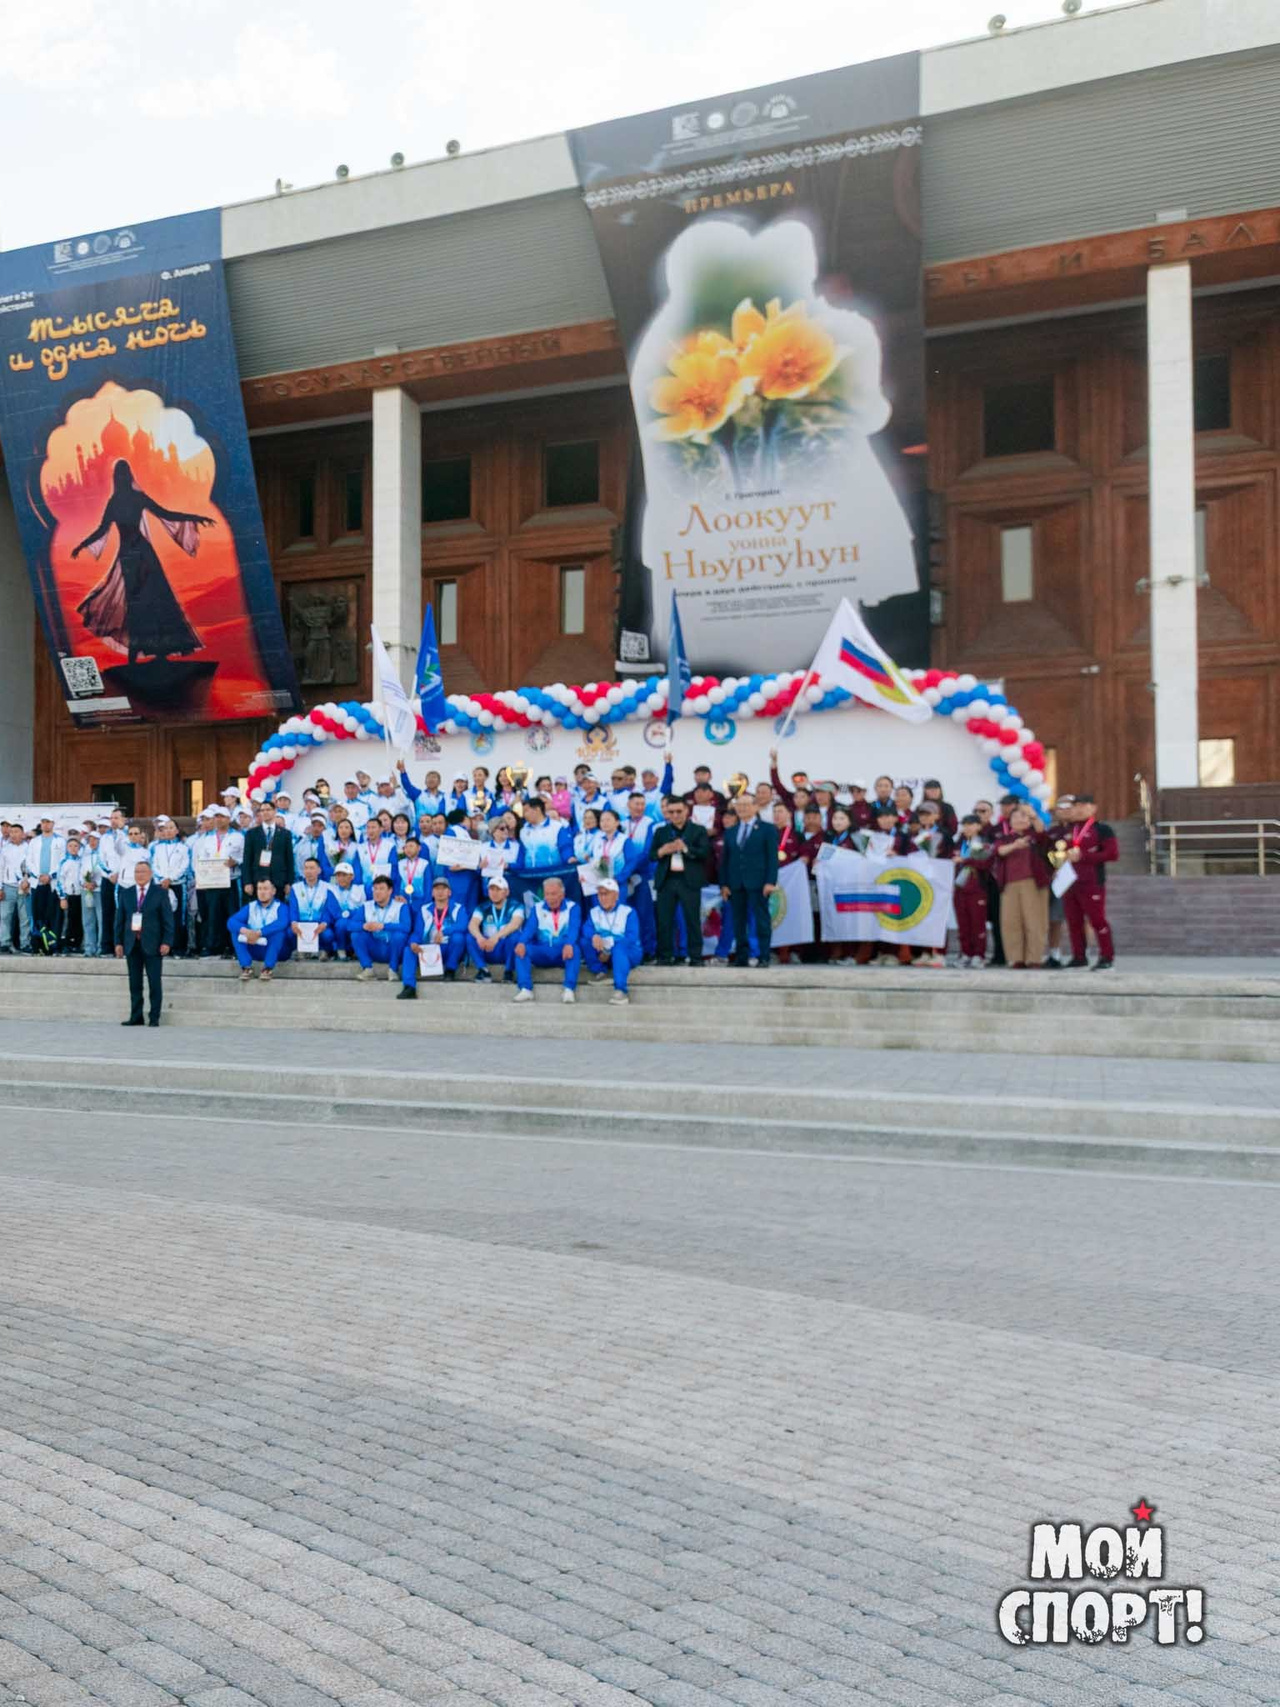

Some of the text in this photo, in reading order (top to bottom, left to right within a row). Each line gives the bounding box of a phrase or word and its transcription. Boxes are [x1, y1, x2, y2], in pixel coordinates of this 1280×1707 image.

[684, 181, 795, 214] ПРЕМЬЕРА
[27, 298, 179, 342] Тысяча
[8, 319, 207, 382] и одна ночь
[678, 500, 837, 537] Лоокуут
